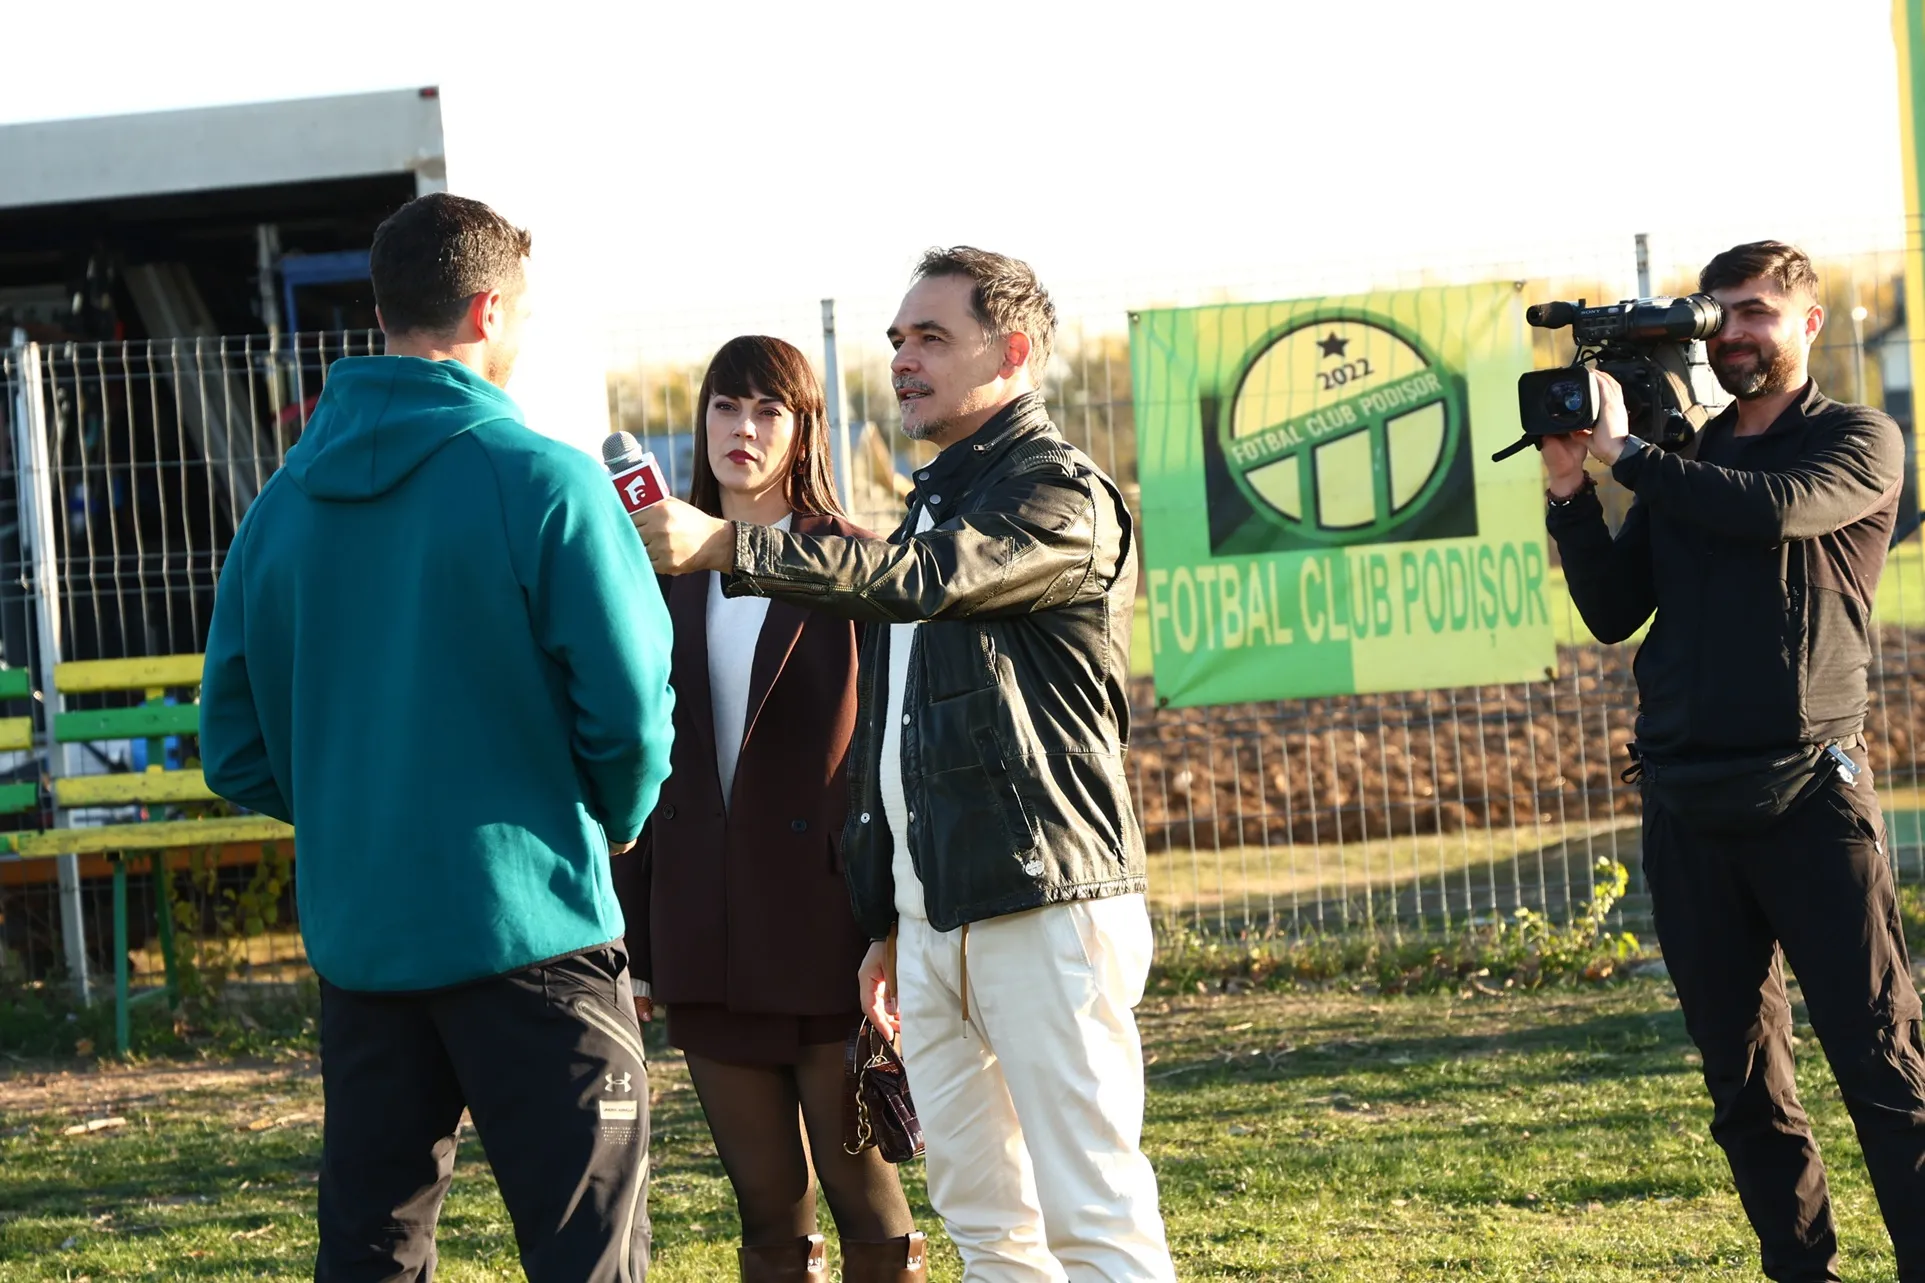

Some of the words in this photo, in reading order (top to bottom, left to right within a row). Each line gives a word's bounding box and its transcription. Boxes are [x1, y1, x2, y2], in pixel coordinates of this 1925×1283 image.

[1316, 359, 1374, 390] 2022
[1231, 425, 1303, 464] FOTBAL
[1305, 404, 1357, 438] CLUB
[1149, 561, 1293, 654] FOTBAL
[1300, 553, 1393, 642] CLUB
